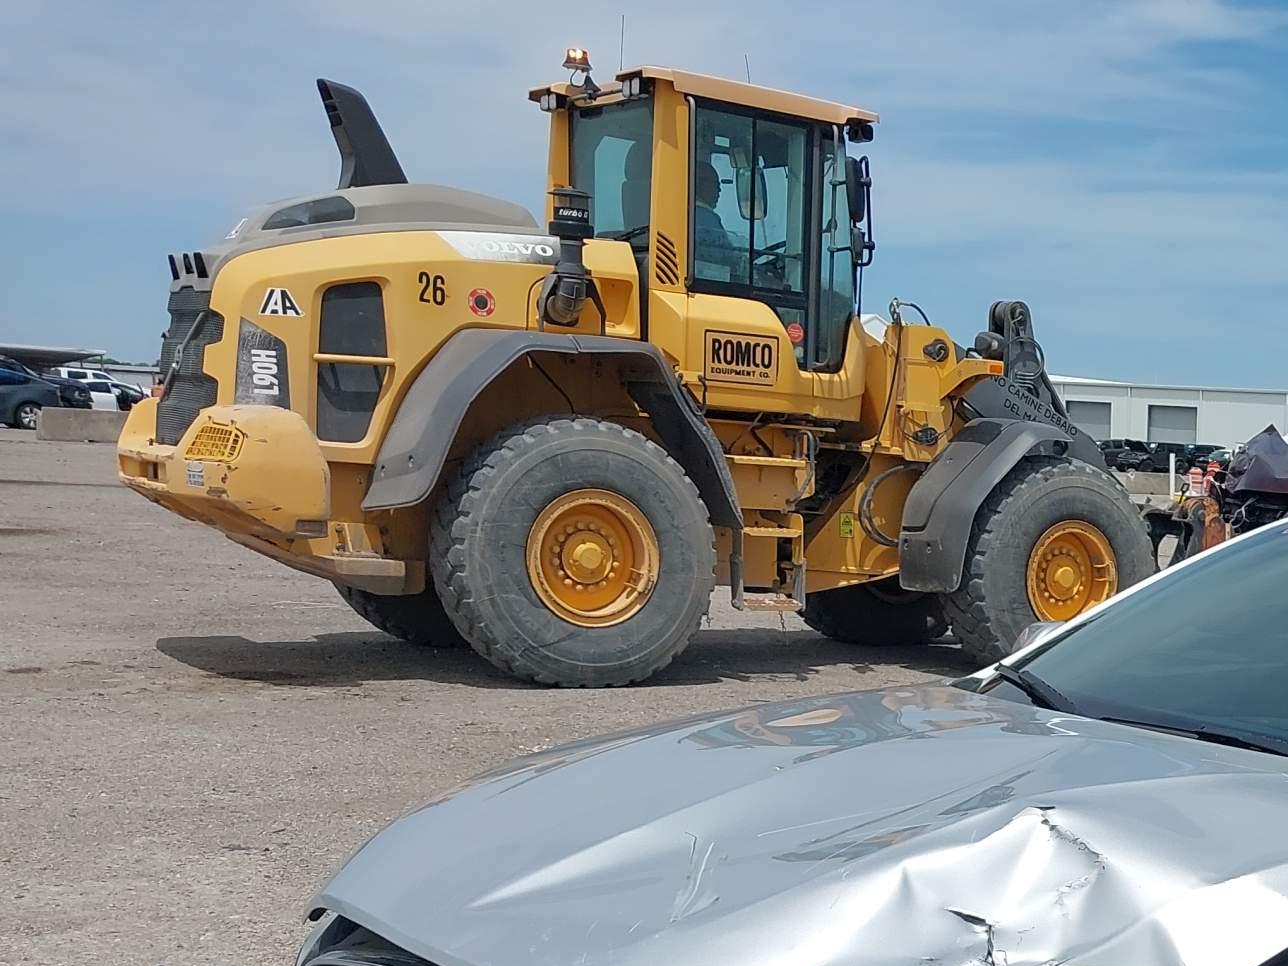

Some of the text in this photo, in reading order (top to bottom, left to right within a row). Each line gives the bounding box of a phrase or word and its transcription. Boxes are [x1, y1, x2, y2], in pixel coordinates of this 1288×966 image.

[558, 208, 582, 218] turbo
[418, 271, 446, 306] 26
[711, 338, 773, 369] ROMCO
[251, 349, 279, 395] L90H
[711, 366, 771, 379] EQUIPMENT CO.
[1003, 398, 1021, 417] DEL
[1007, 384, 1043, 414] CAMINE
[1043, 408, 1078, 436] DEBAJO
